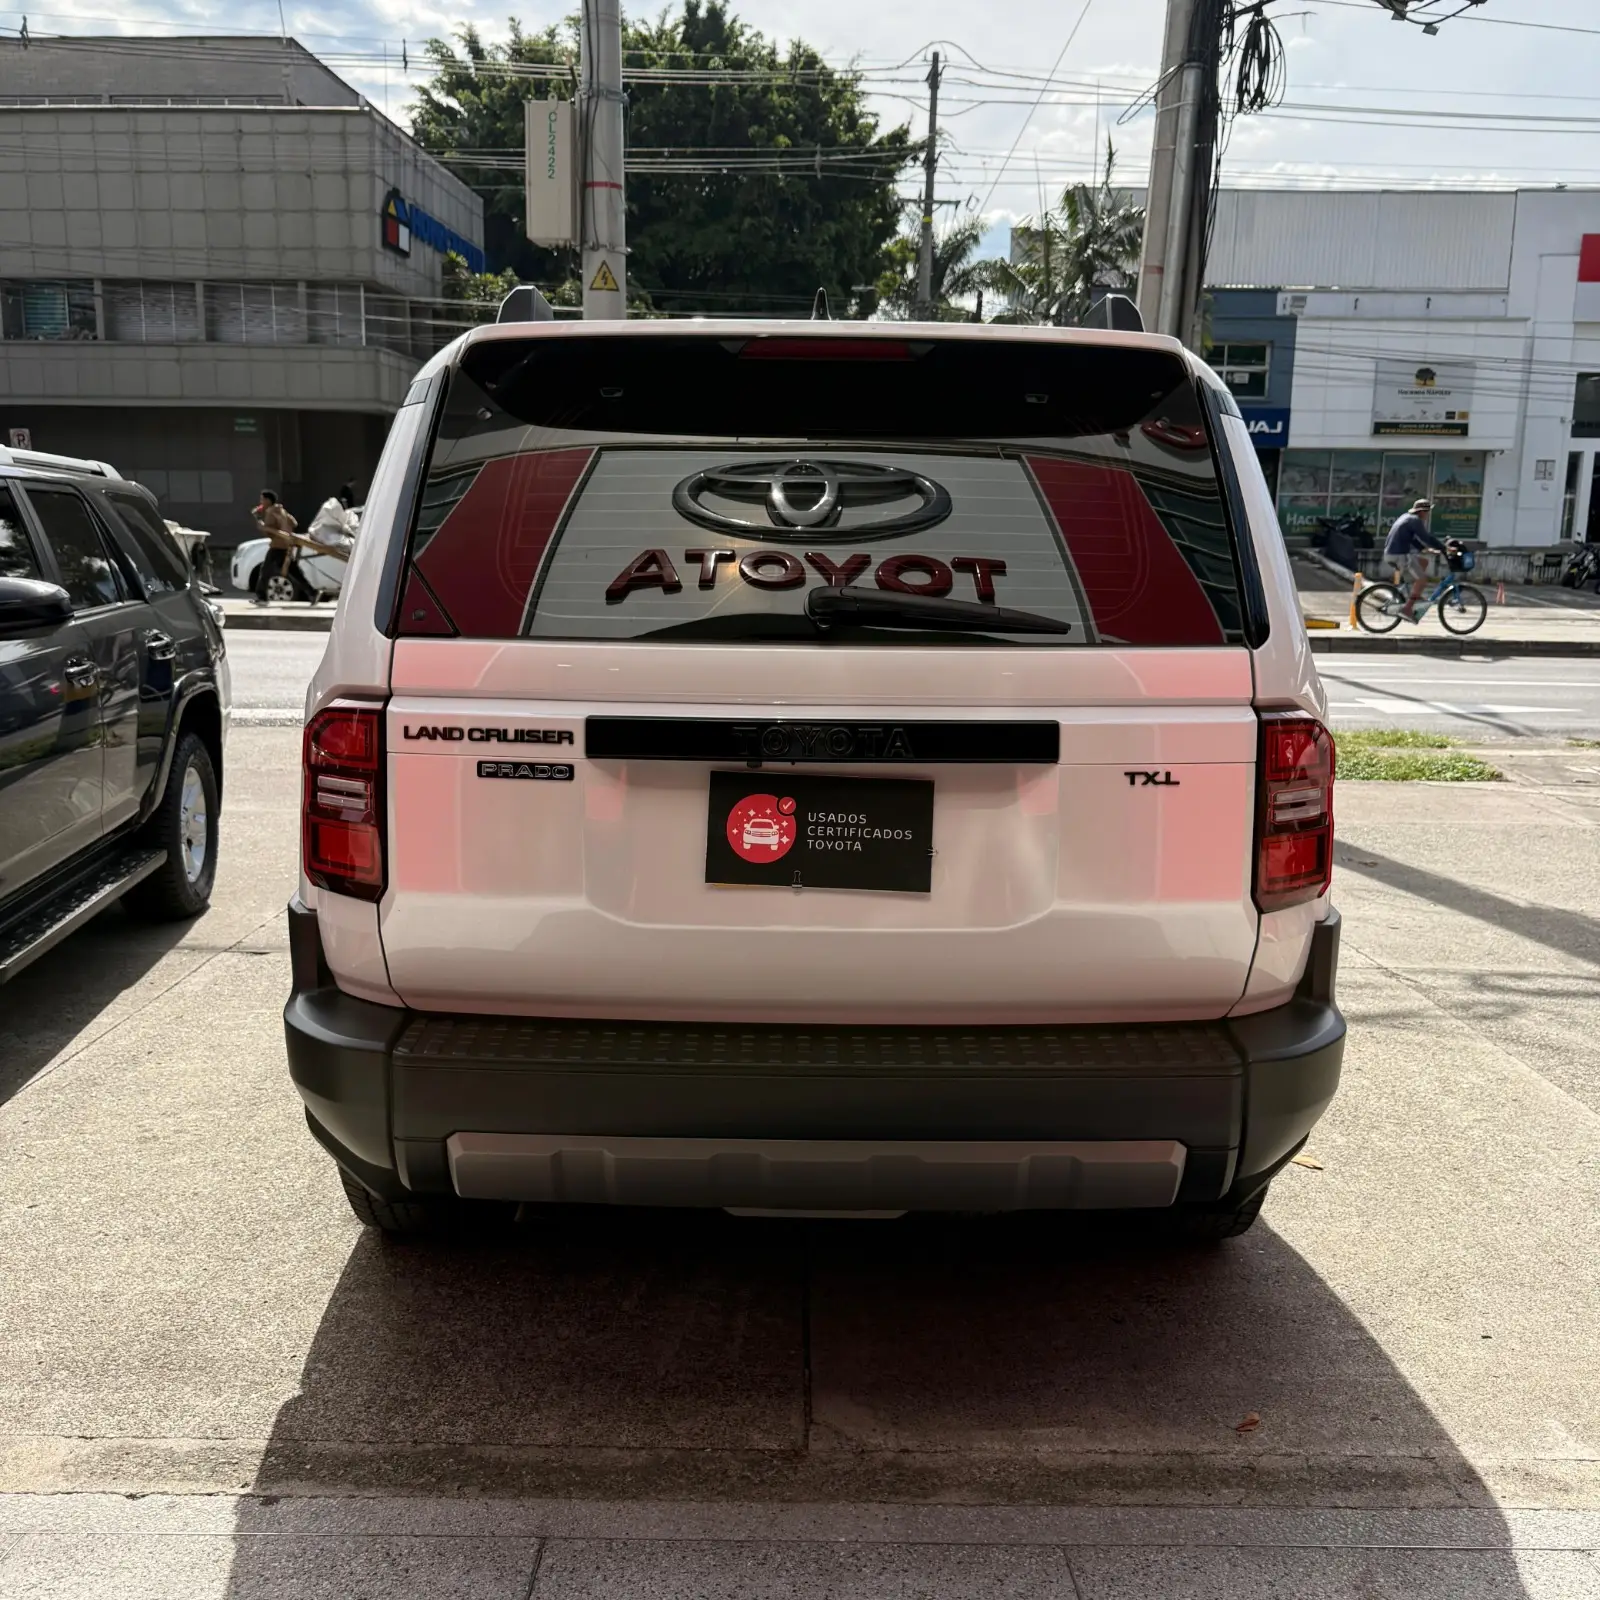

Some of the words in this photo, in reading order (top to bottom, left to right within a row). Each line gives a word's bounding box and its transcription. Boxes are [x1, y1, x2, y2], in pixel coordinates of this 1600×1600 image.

[403, 725, 465, 741] LAND
[467, 727, 575, 745] CRUISER
[732, 725, 915, 758] TOYOTA
[480, 763, 571, 779] PRADO
[1123, 771, 1181, 786] TXL
[807, 812, 867, 825] USADOS
[807, 826, 914, 840] CERTIFICADOS
[806, 839, 863, 852] TOYOTA
